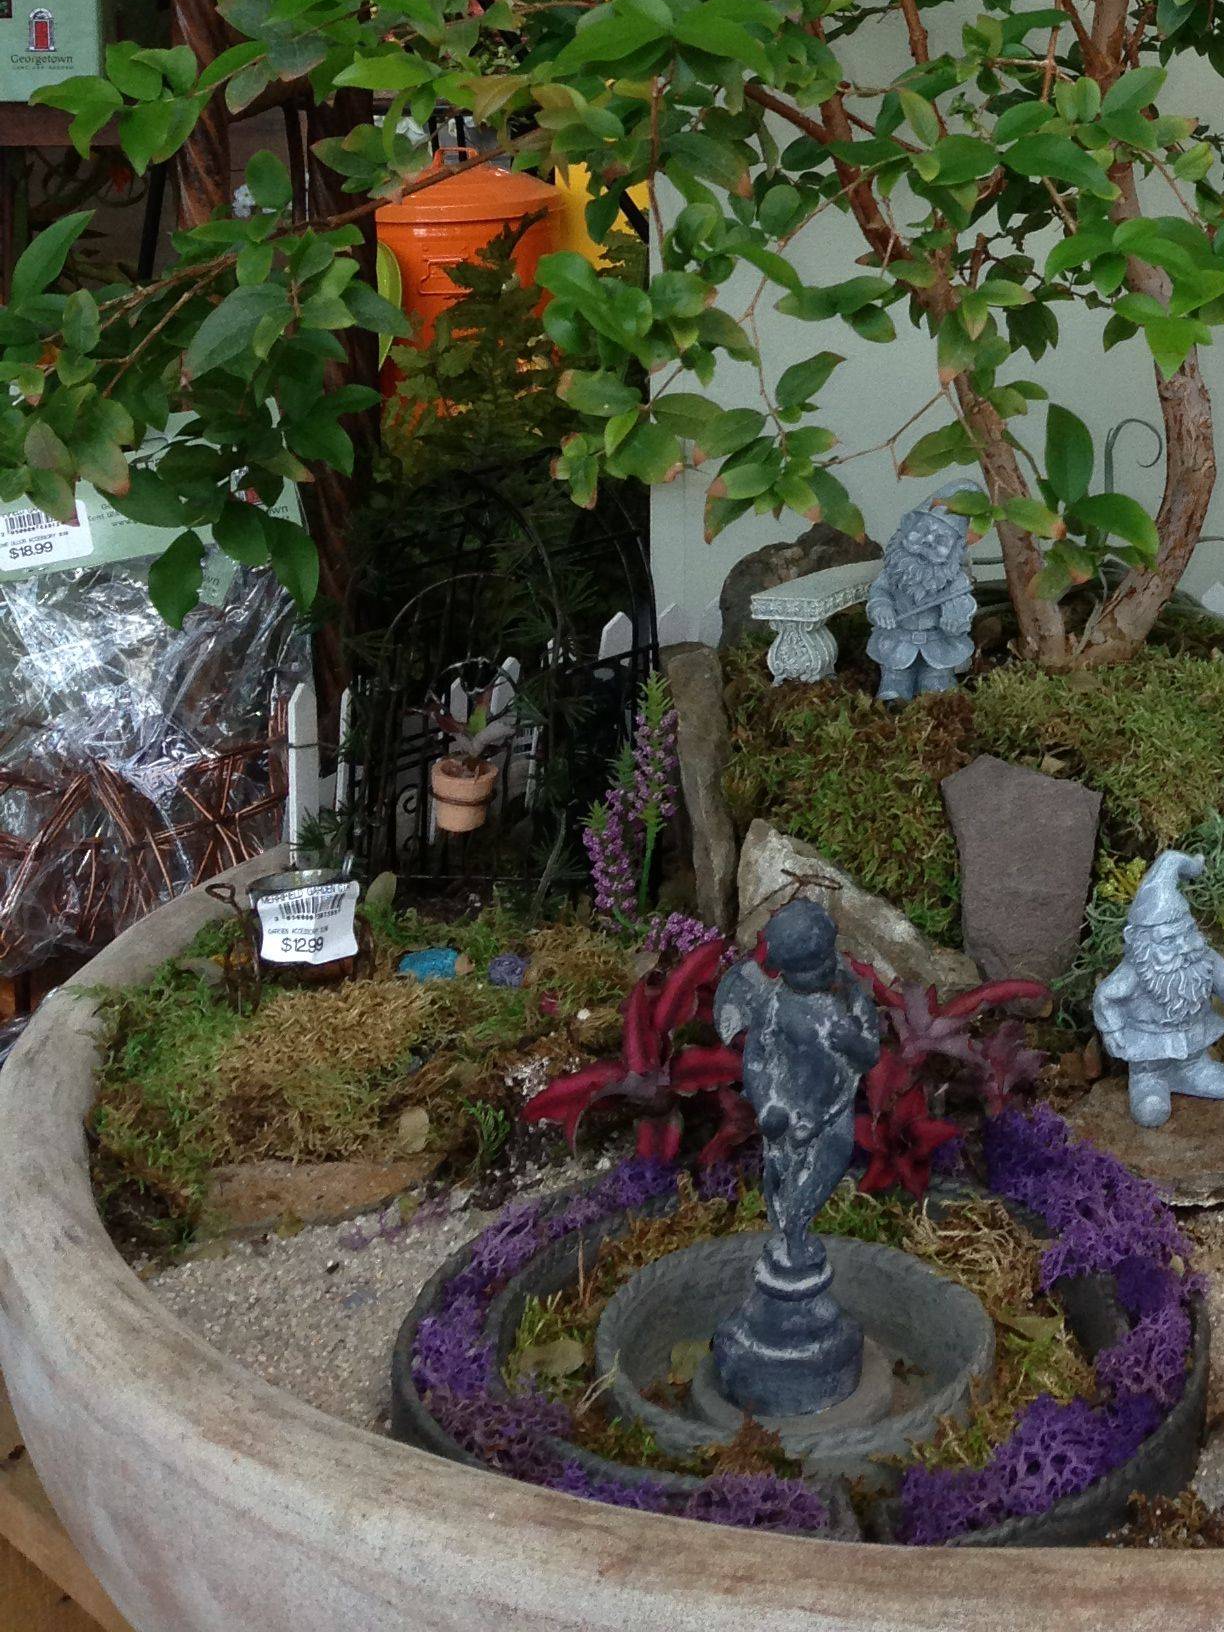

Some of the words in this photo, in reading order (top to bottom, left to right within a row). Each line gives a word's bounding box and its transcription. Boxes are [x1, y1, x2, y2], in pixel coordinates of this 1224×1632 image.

[10, 54, 73, 65] Georgetown
[9, 541, 53, 559] $18.99
[281, 936, 324, 954] $12.99
